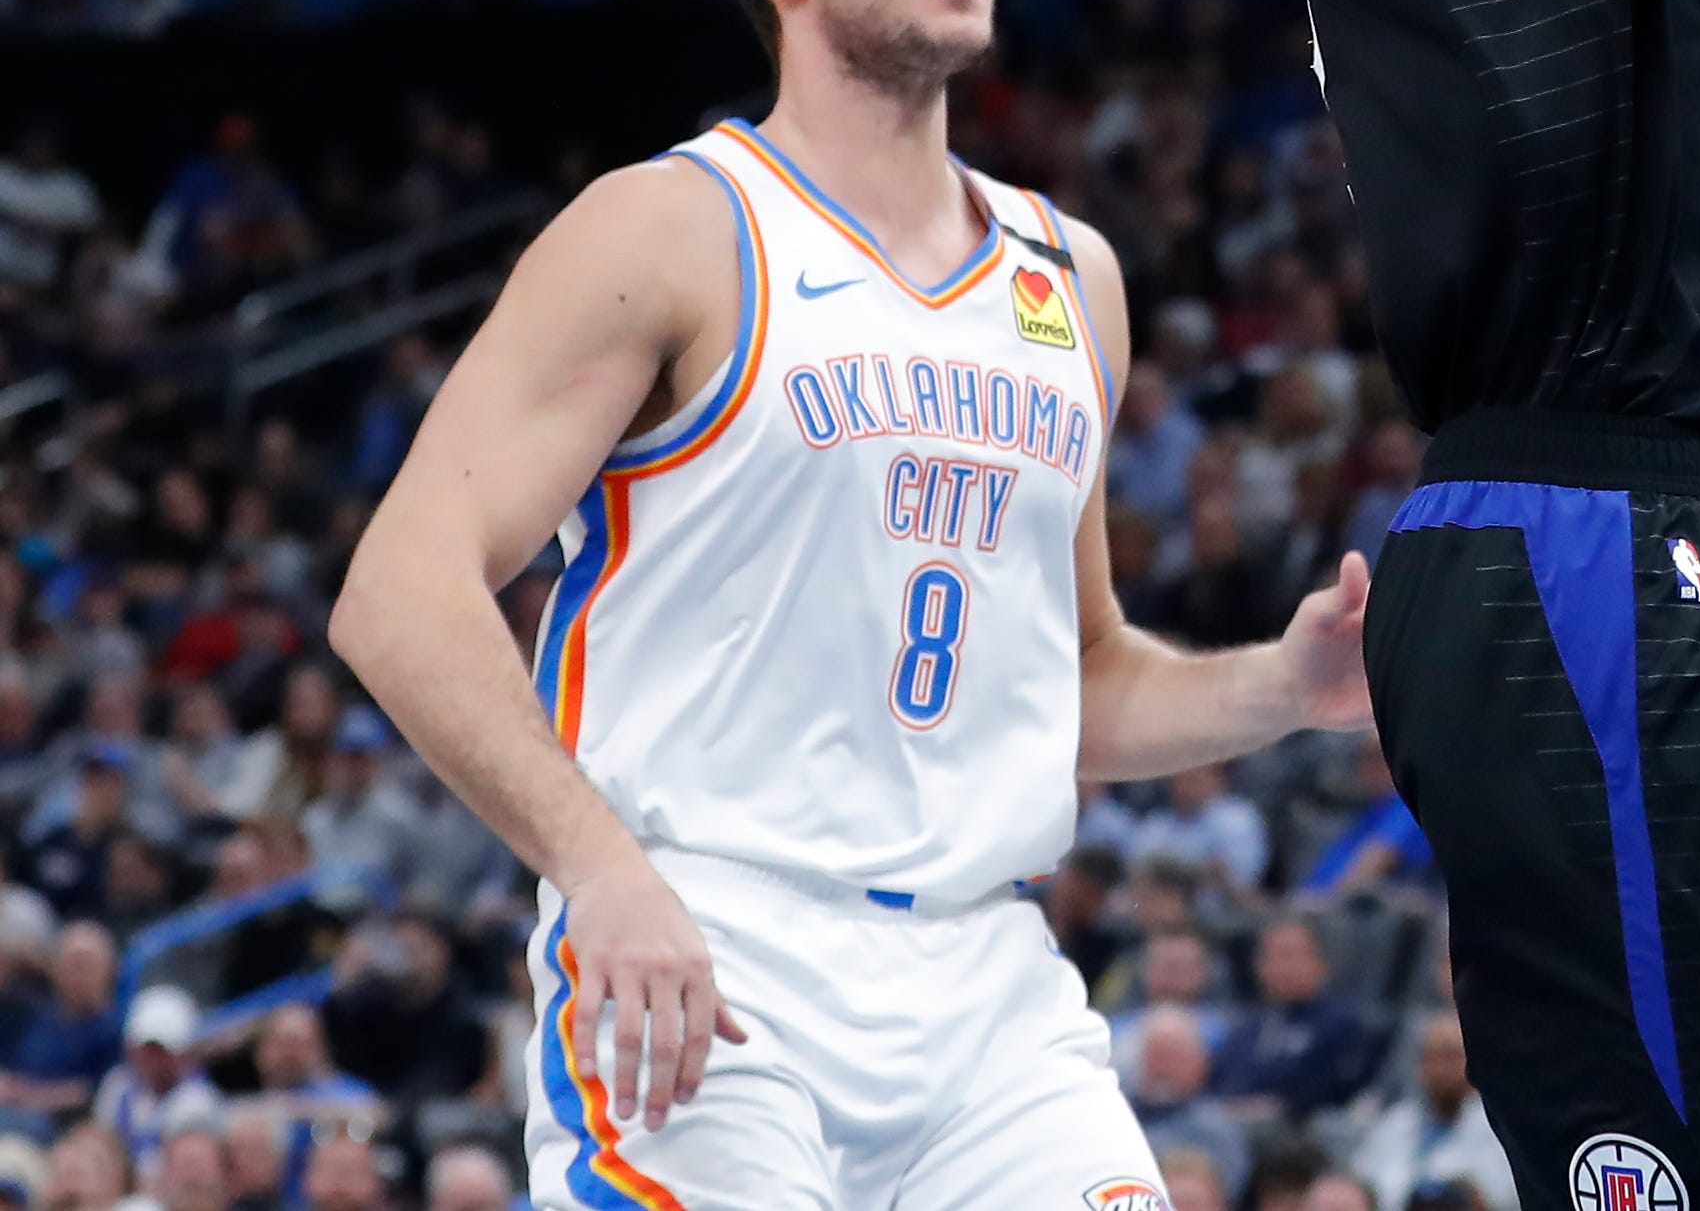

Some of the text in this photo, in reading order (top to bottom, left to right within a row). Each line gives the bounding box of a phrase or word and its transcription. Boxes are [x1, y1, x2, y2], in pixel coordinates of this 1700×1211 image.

[784, 354, 1091, 487] OKLAHOMA
[884, 452, 1018, 551] CITY
[888, 559, 970, 730] 8
